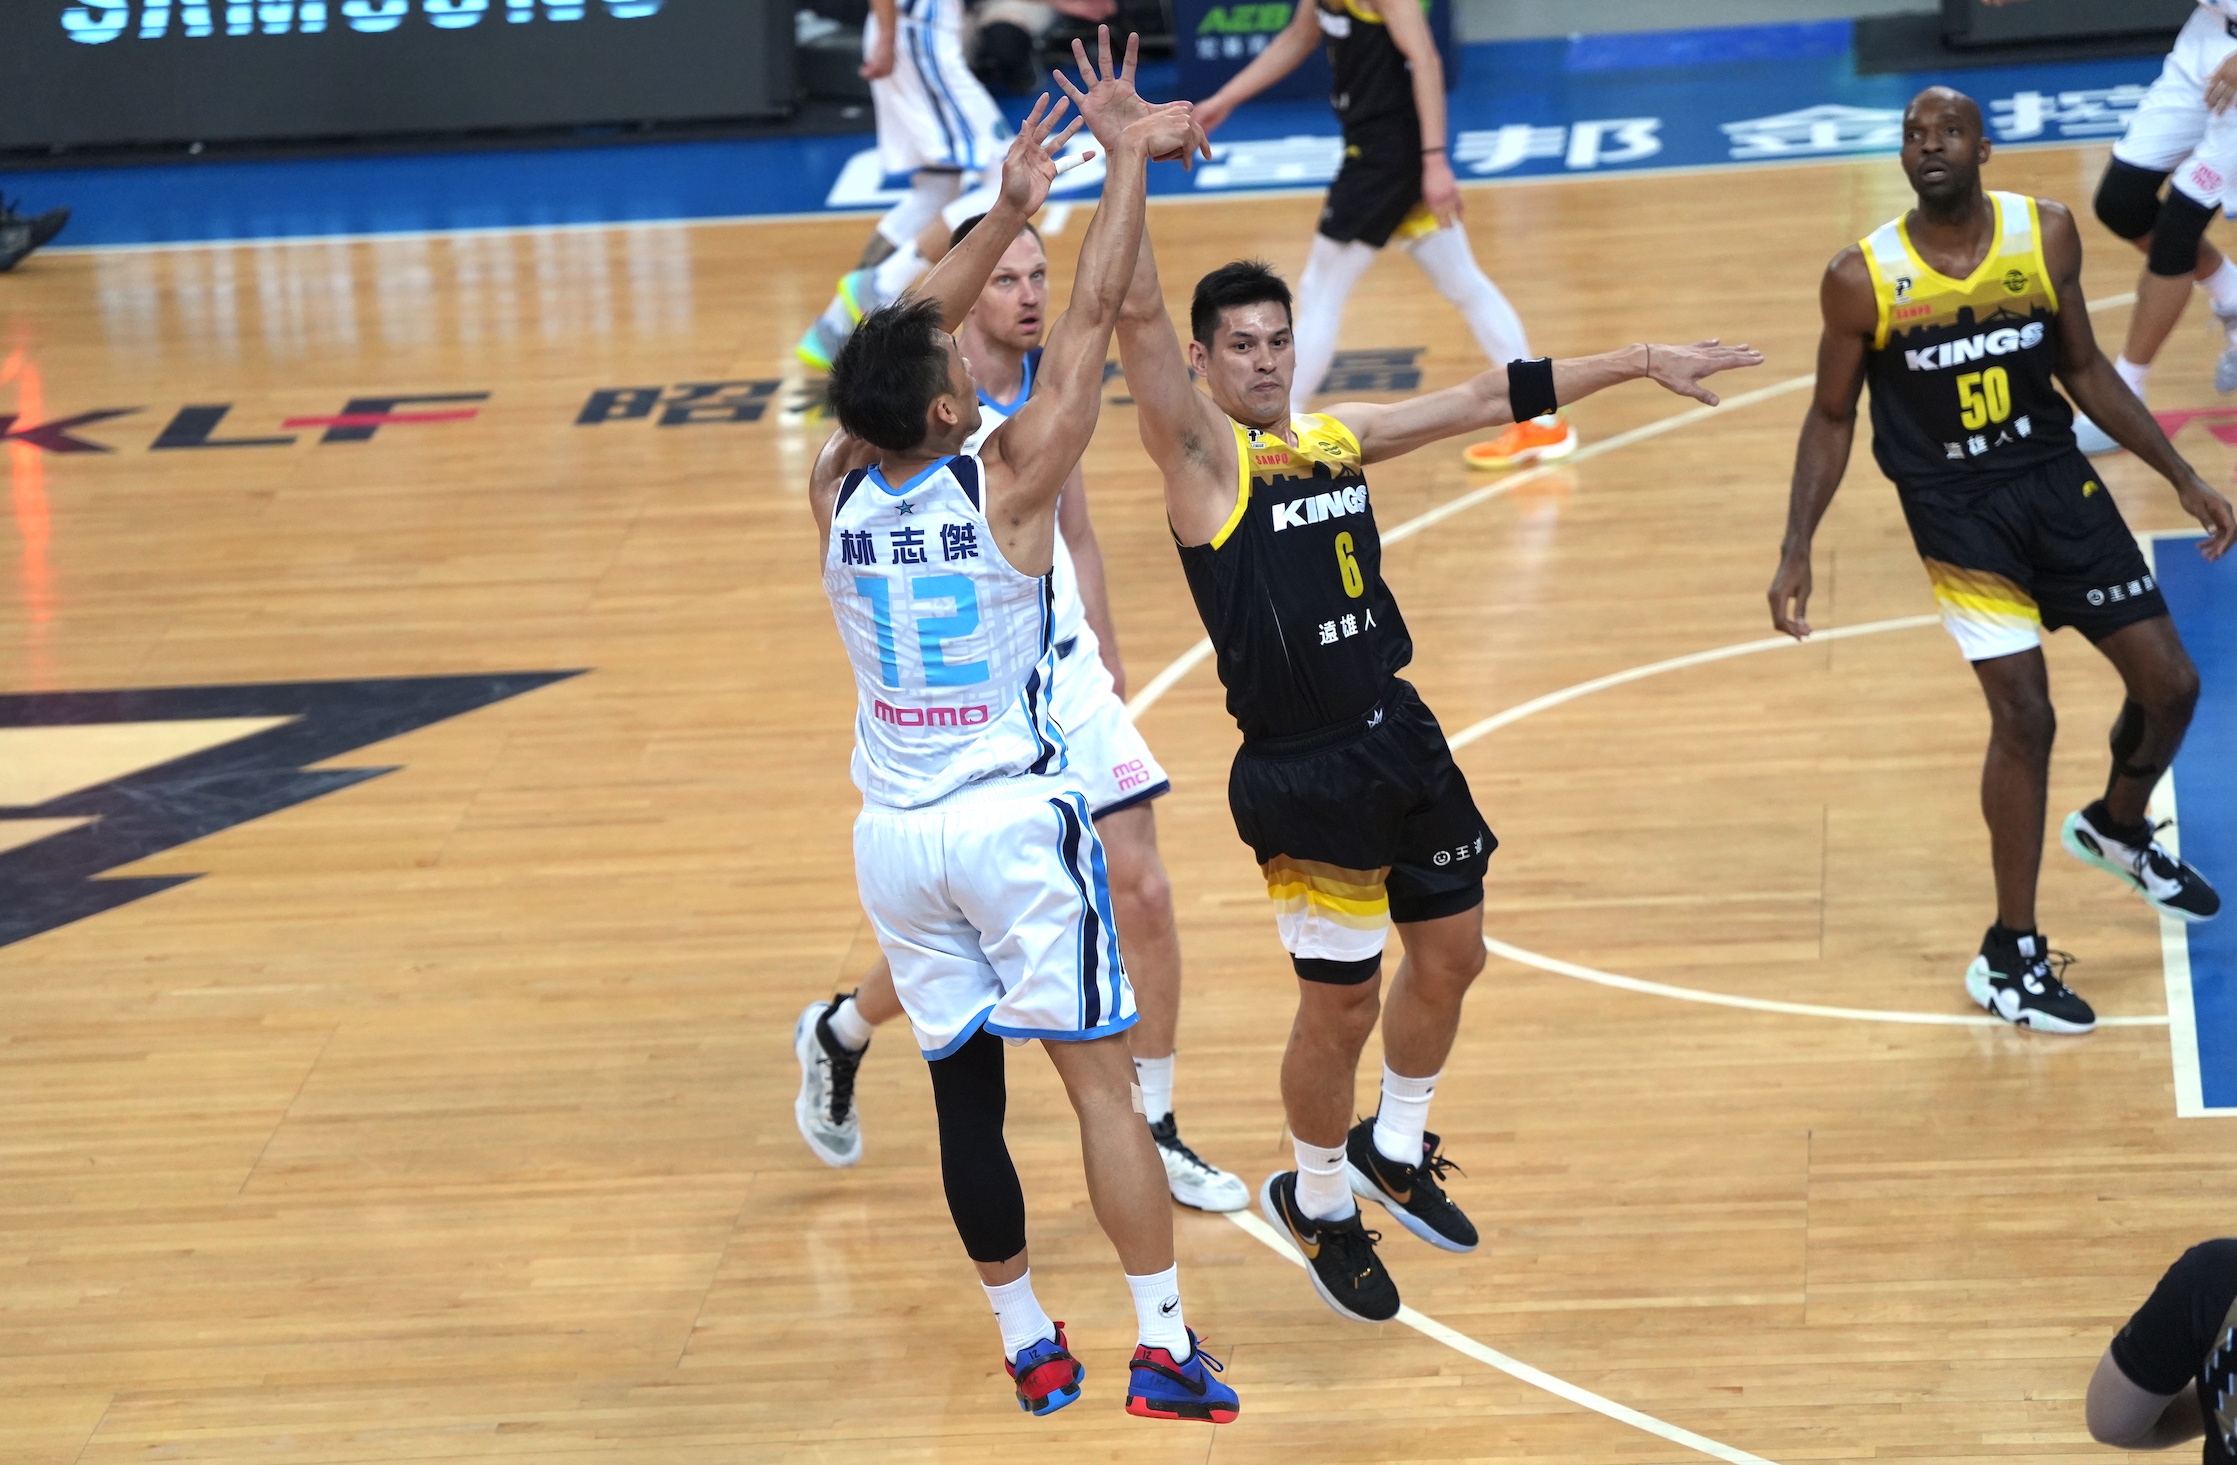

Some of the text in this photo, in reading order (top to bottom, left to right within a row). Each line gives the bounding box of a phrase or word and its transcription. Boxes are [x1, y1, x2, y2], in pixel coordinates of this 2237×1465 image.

[1904, 322, 2044, 371] KINGS
[1956, 366, 2011, 430] 50
[1255, 453, 1289, 465] SAMPO
[1272, 485, 1367, 532] KINGS
[840, 522, 978, 565] 林志傑
[1335, 531, 1364, 598] 6
[854, 574, 990, 687] 12
[875, 699, 989, 726] momo
[1028, 1349, 1041, 1360] 12
[1142, 1350, 1152, 1360] 12
